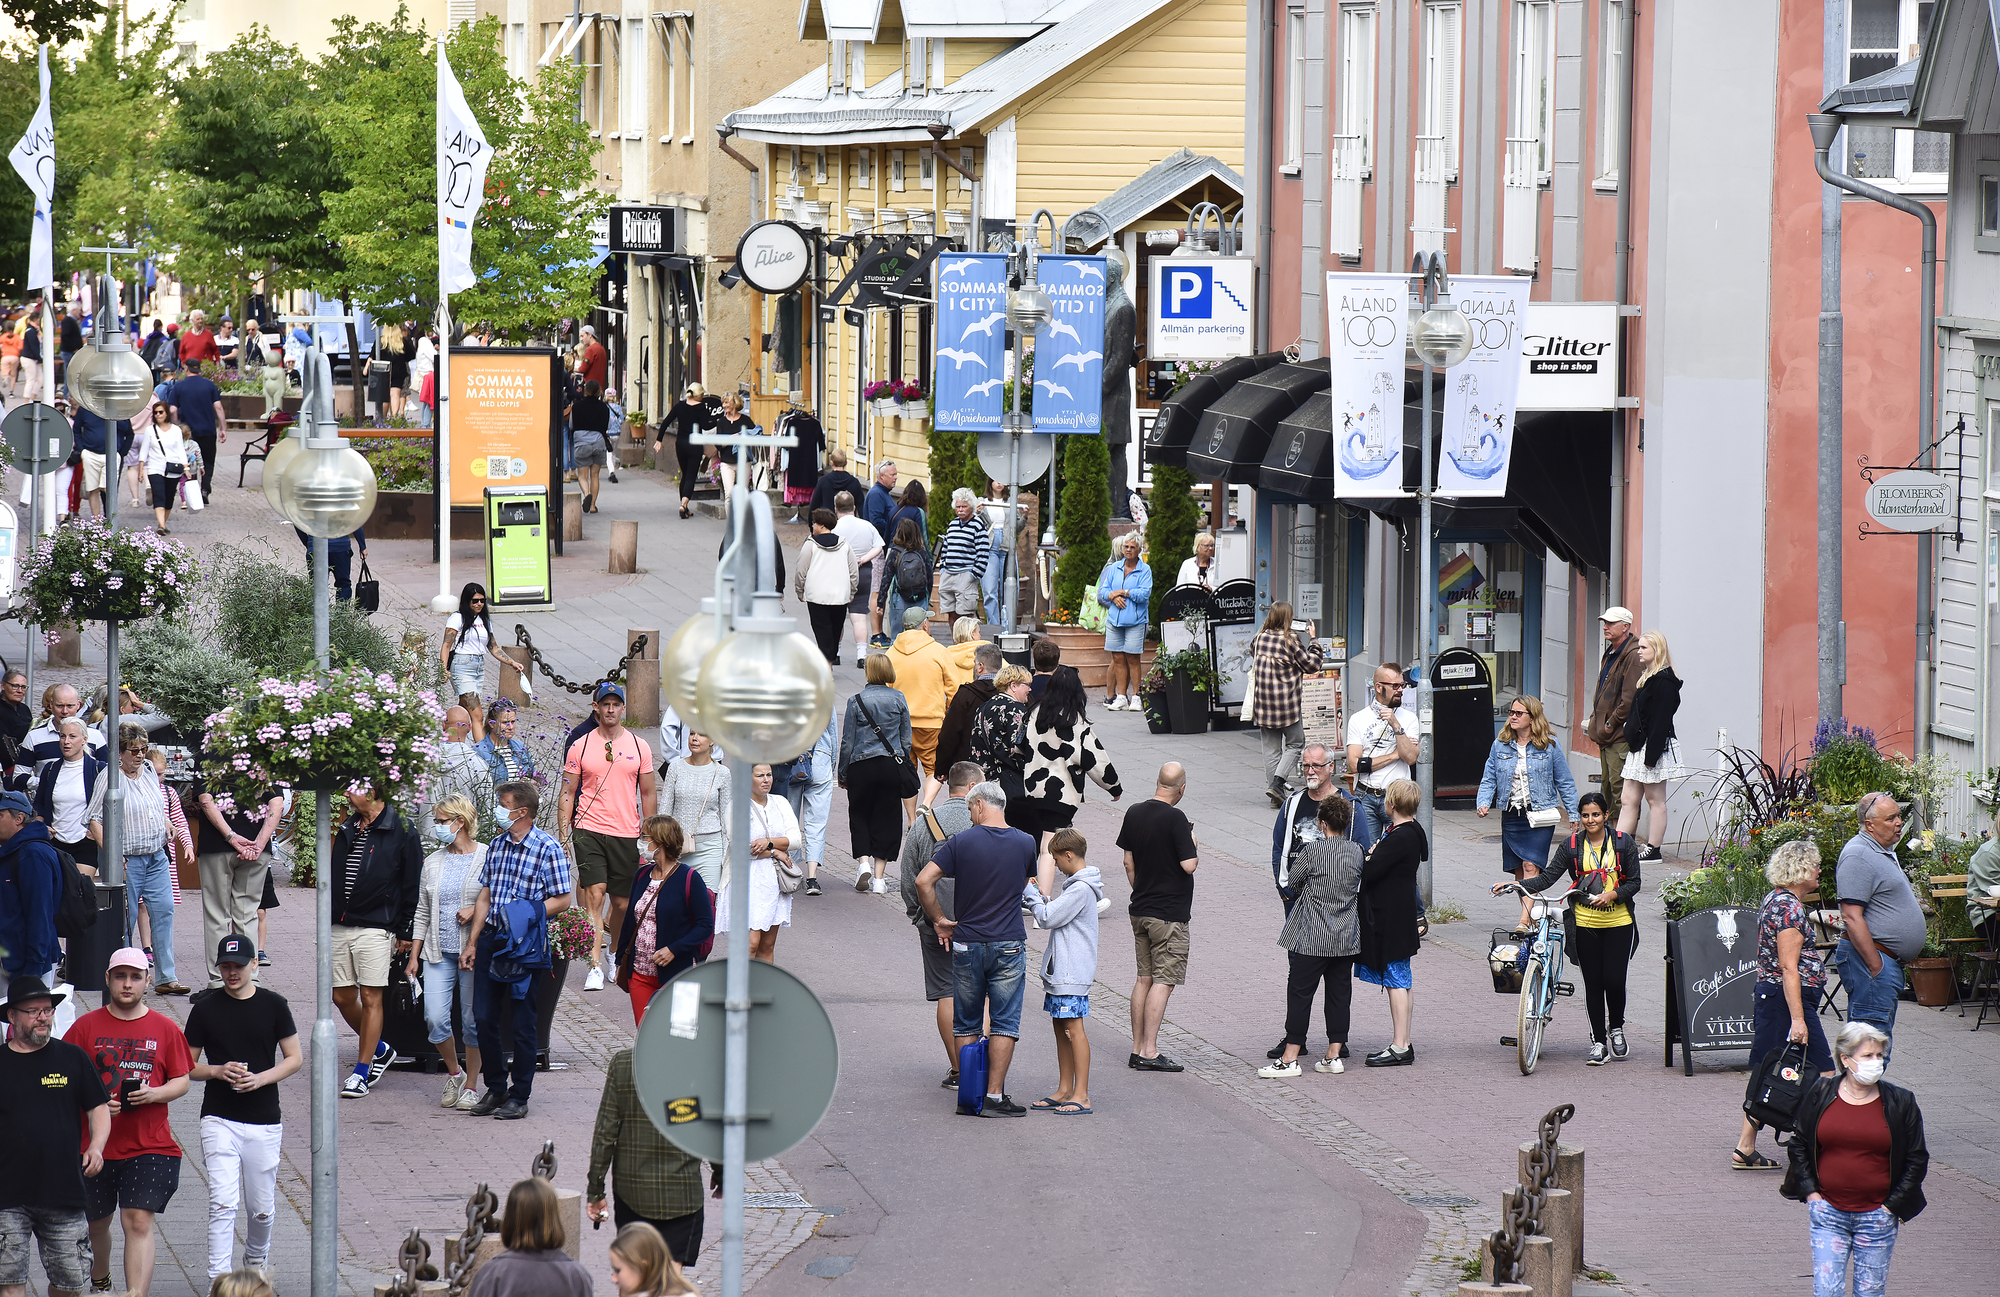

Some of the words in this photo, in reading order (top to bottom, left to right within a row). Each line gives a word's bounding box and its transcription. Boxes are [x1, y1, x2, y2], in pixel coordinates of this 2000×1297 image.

[622, 211, 662, 244] BUTIKEN
[754, 248, 796, 269] Alice
[940, 281, 1006, 294] SOMMAR
[1171, 271, 1203, 314] P
[949, 297, 954, 311] I
[959, 297, 997, 311] CITY
[1340, 295, 1397, 313] ÅLAND
[1160, 324, 1195, 333] Allmän
[1197, 324, 1245, 335] parkering
[1341, 315, 1397, 347] 100
[1522, 335, 1612, 357] Glitter
[1536, 362, 1559, 372] shop
[1560, 362, 1570, 371] in
[1571, 362, 1593, 372] shop
[467, 374, 534, 387] SOMMAR
[465, 387, 535, 399] MARKNAD
[950, 409, 1001, 427] Mariehamn
[1879, 488, 1944, 499] BLOMBERGS
[1877, 498, 1946, 516] blomsterhandel
[1447, 588, 1480, 602] mjuk
[1480, 585, 1496, 603] &
[1496, 588, 1516, 600] len
[1442, 667, 1458, 676] mjuk
[1464, 666, 1474, 674] len
[1692, 970, 1723, 999] Café
[1724, 965, 1737, 979] &
[1706, 1021, 1756, 1035] VIKTO
[147, 1041, 156, 1049] IS
[119, 1060, 154, 1071] ANSWER
